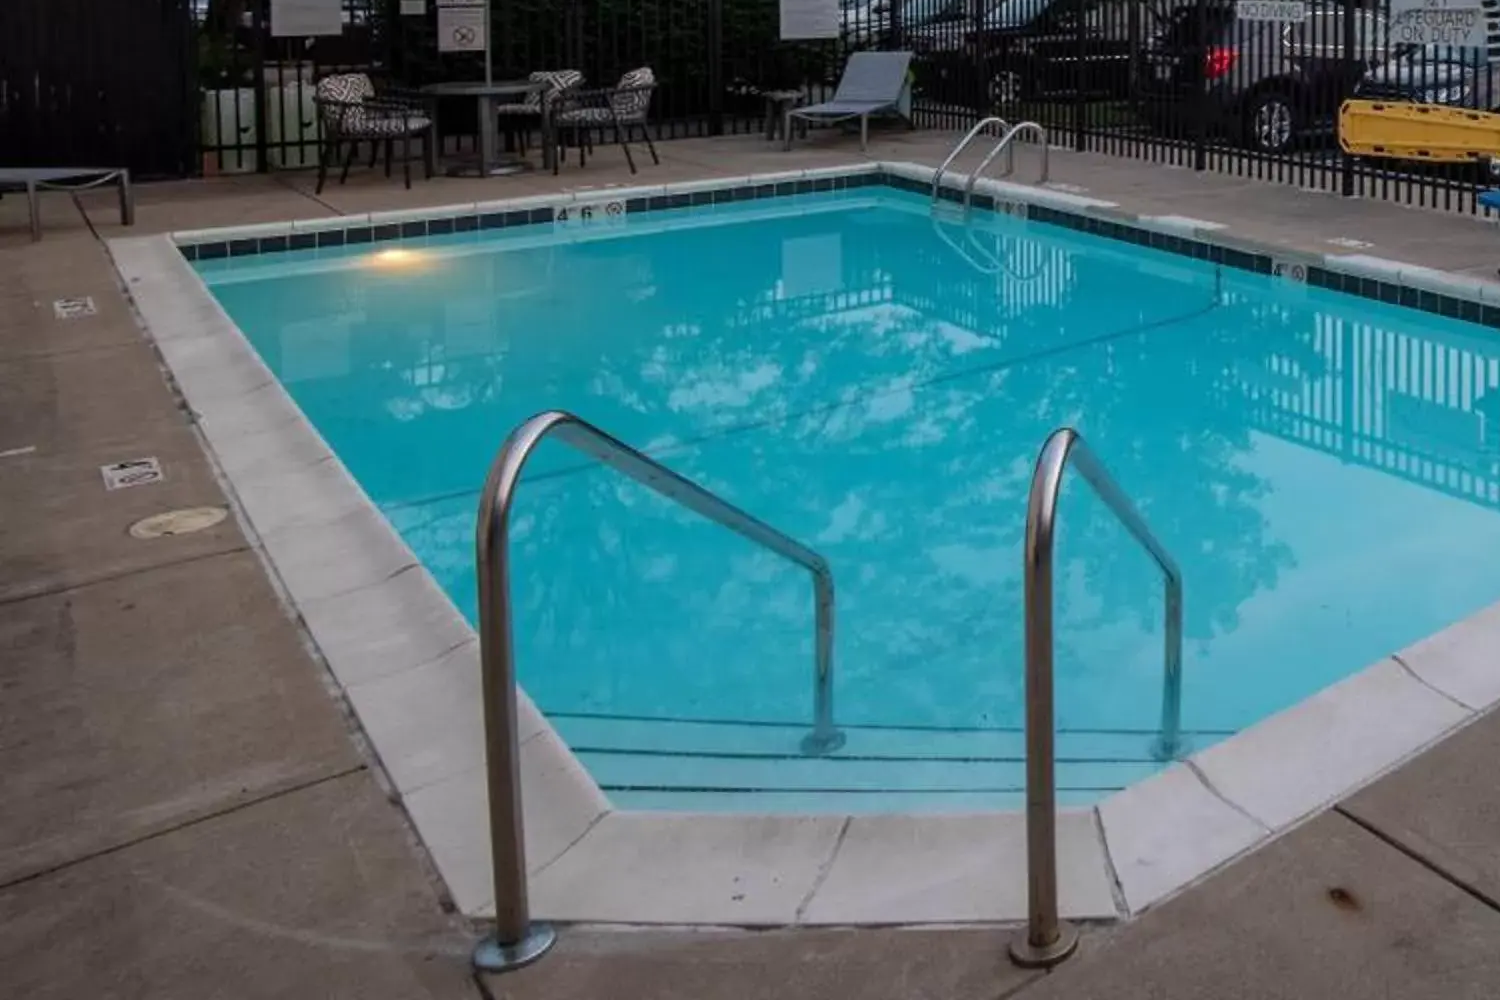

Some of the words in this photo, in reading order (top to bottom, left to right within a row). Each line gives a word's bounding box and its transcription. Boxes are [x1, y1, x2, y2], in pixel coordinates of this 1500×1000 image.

[1241, 3, 1259, 17] NO
[1401, 26, 1423, 41] ON
[1432, 26, 1470, 43] DUTY
